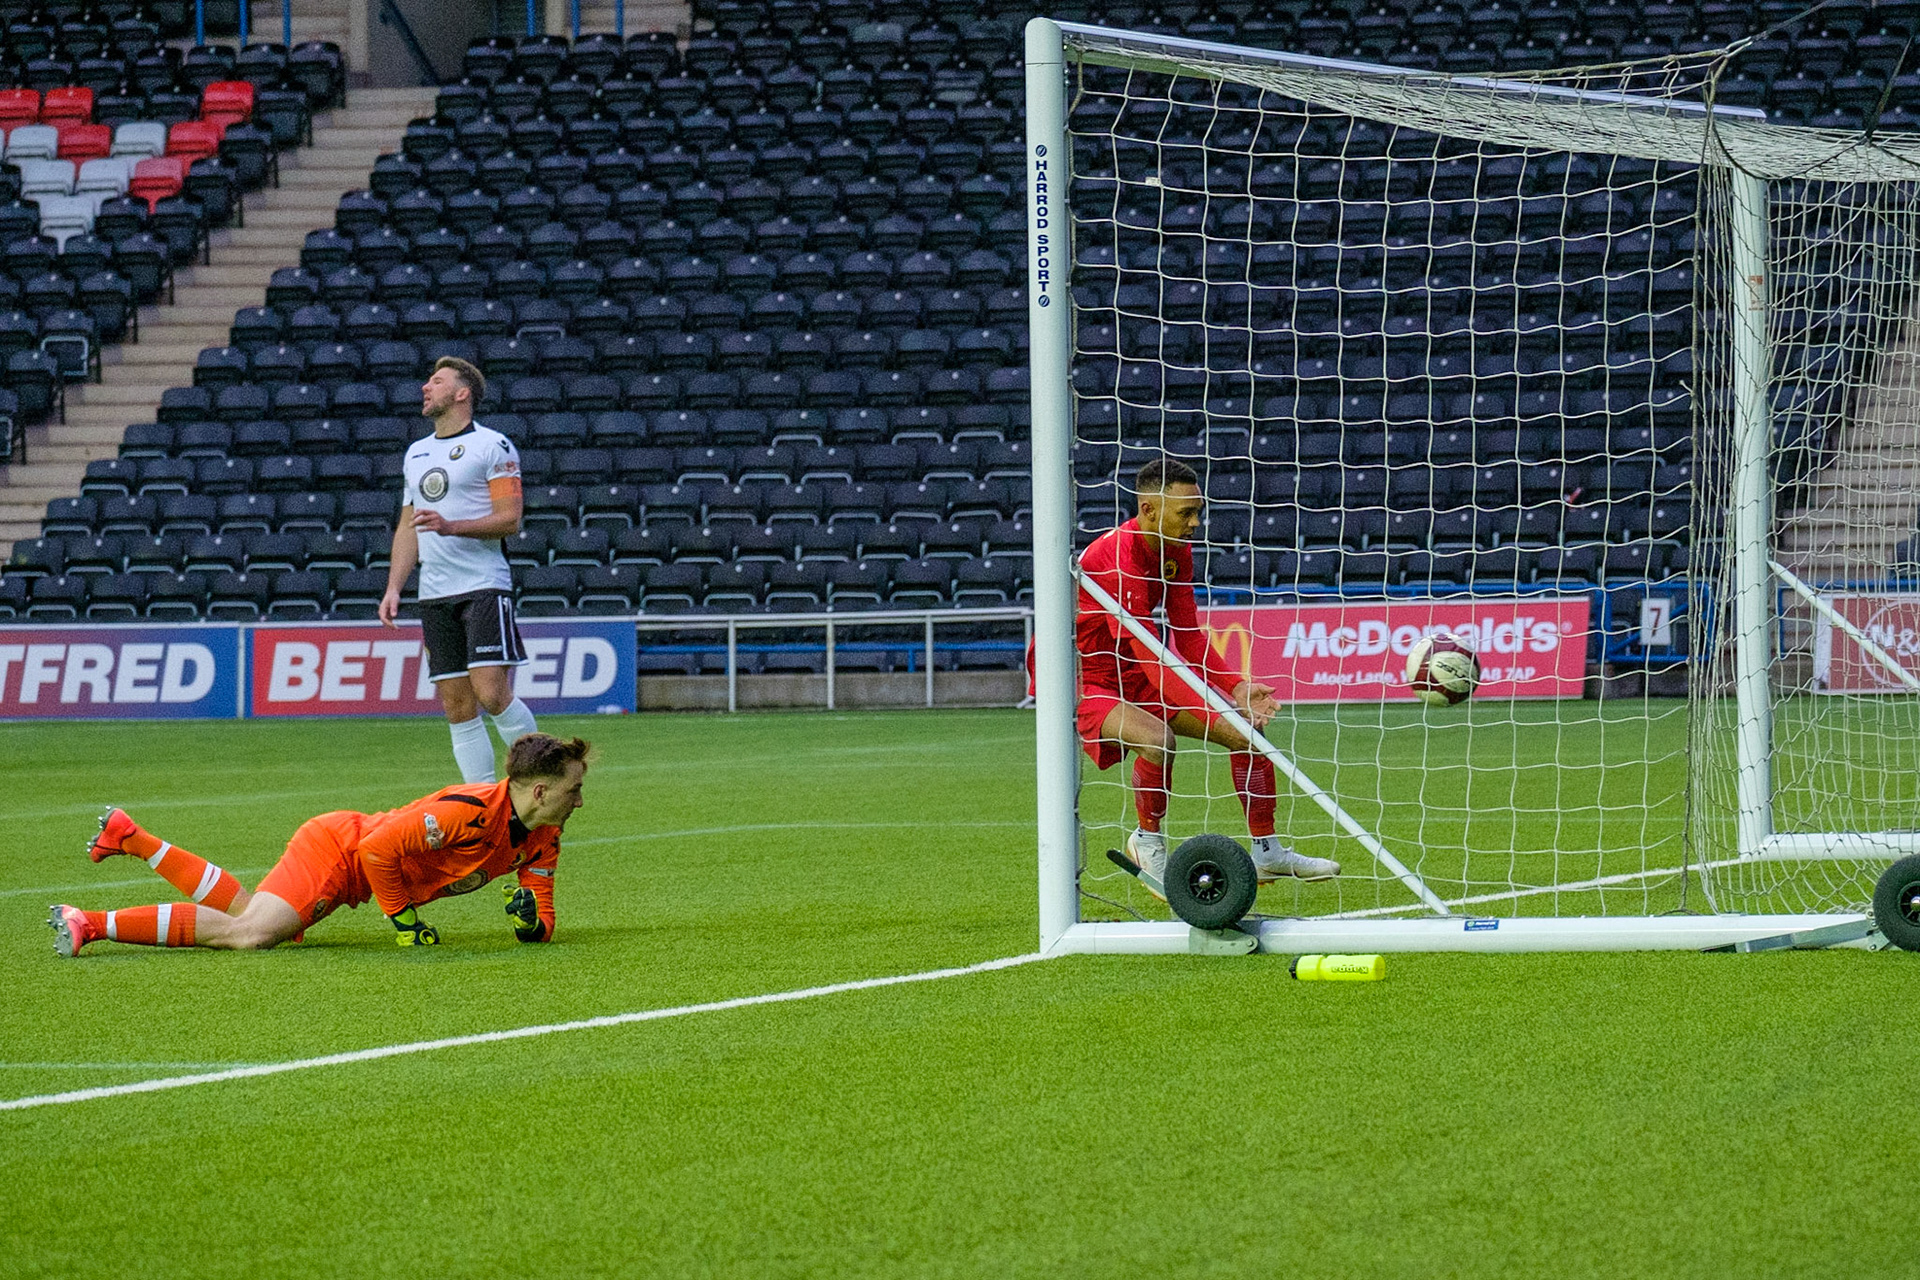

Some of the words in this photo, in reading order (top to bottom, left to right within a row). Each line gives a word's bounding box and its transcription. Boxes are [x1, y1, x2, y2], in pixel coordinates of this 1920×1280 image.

[1036, 160, 1048, 229] HARROD
[1037, 234, 1049, 292] SPORT
[1650, 607, 1662, 638] 7
[267, 636, 618, 703] BETED
[1313, 671, 1353, 685] Moor
